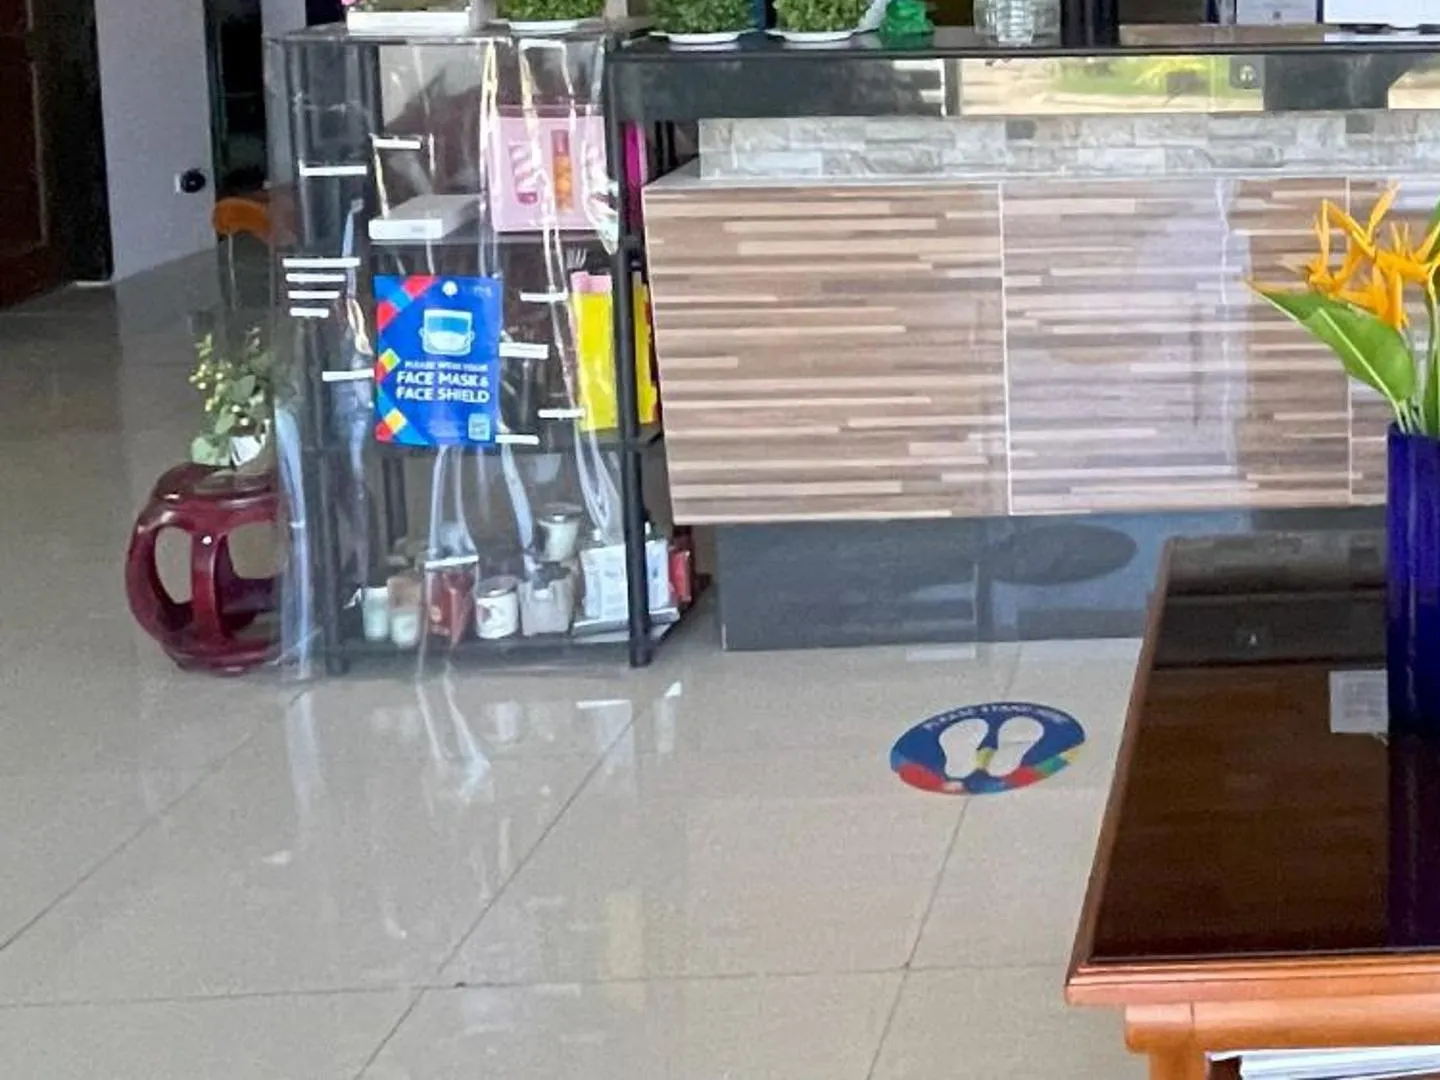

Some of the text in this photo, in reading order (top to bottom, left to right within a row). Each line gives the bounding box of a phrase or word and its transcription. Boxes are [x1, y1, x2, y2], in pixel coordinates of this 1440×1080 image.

[396, 371, 433, 386] FACE
[437, 372, 478, 387] MASK
[396, 386, 491, 403] FACE SHIELD
